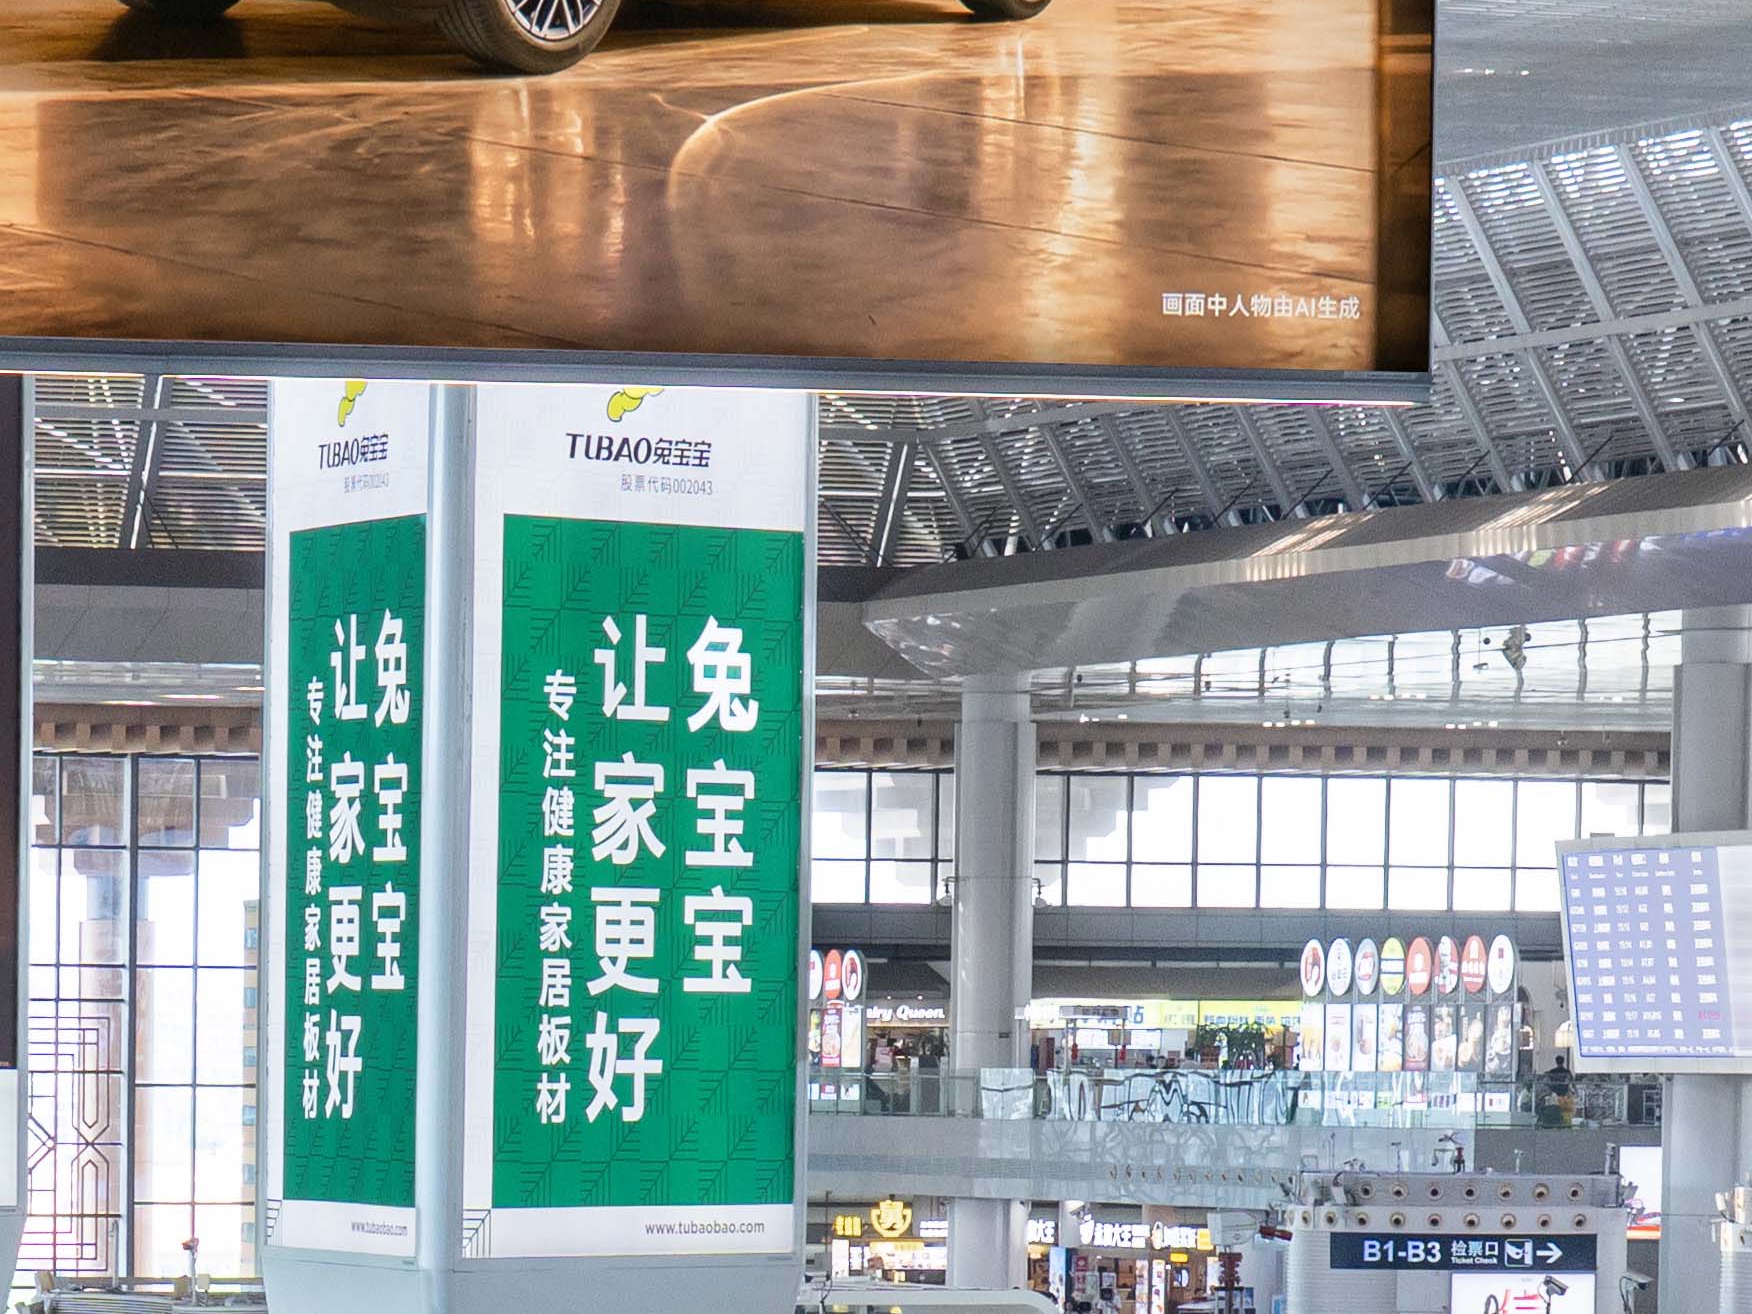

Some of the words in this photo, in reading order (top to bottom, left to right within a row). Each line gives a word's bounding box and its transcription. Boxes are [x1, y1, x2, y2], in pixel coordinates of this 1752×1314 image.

[1162, 292, 1362, 320] 画面中人物由AI生成
[621, 474, 713, 496] 股票代码002043
[303, 675, 324, 1120] 专注健康家居板材
[536, 669, 578, 1124] 专注健康家居板材
[645, 1221, 765, 1236] www.tubaobao.com
[1363, 1240, 1441, 1262] B1-B3
[1451, 1240, 1499, 1257] 检票口
[1451, 1256, 1473, 1264] Ticket
[1475, 1256, 1498, 1264] Check
